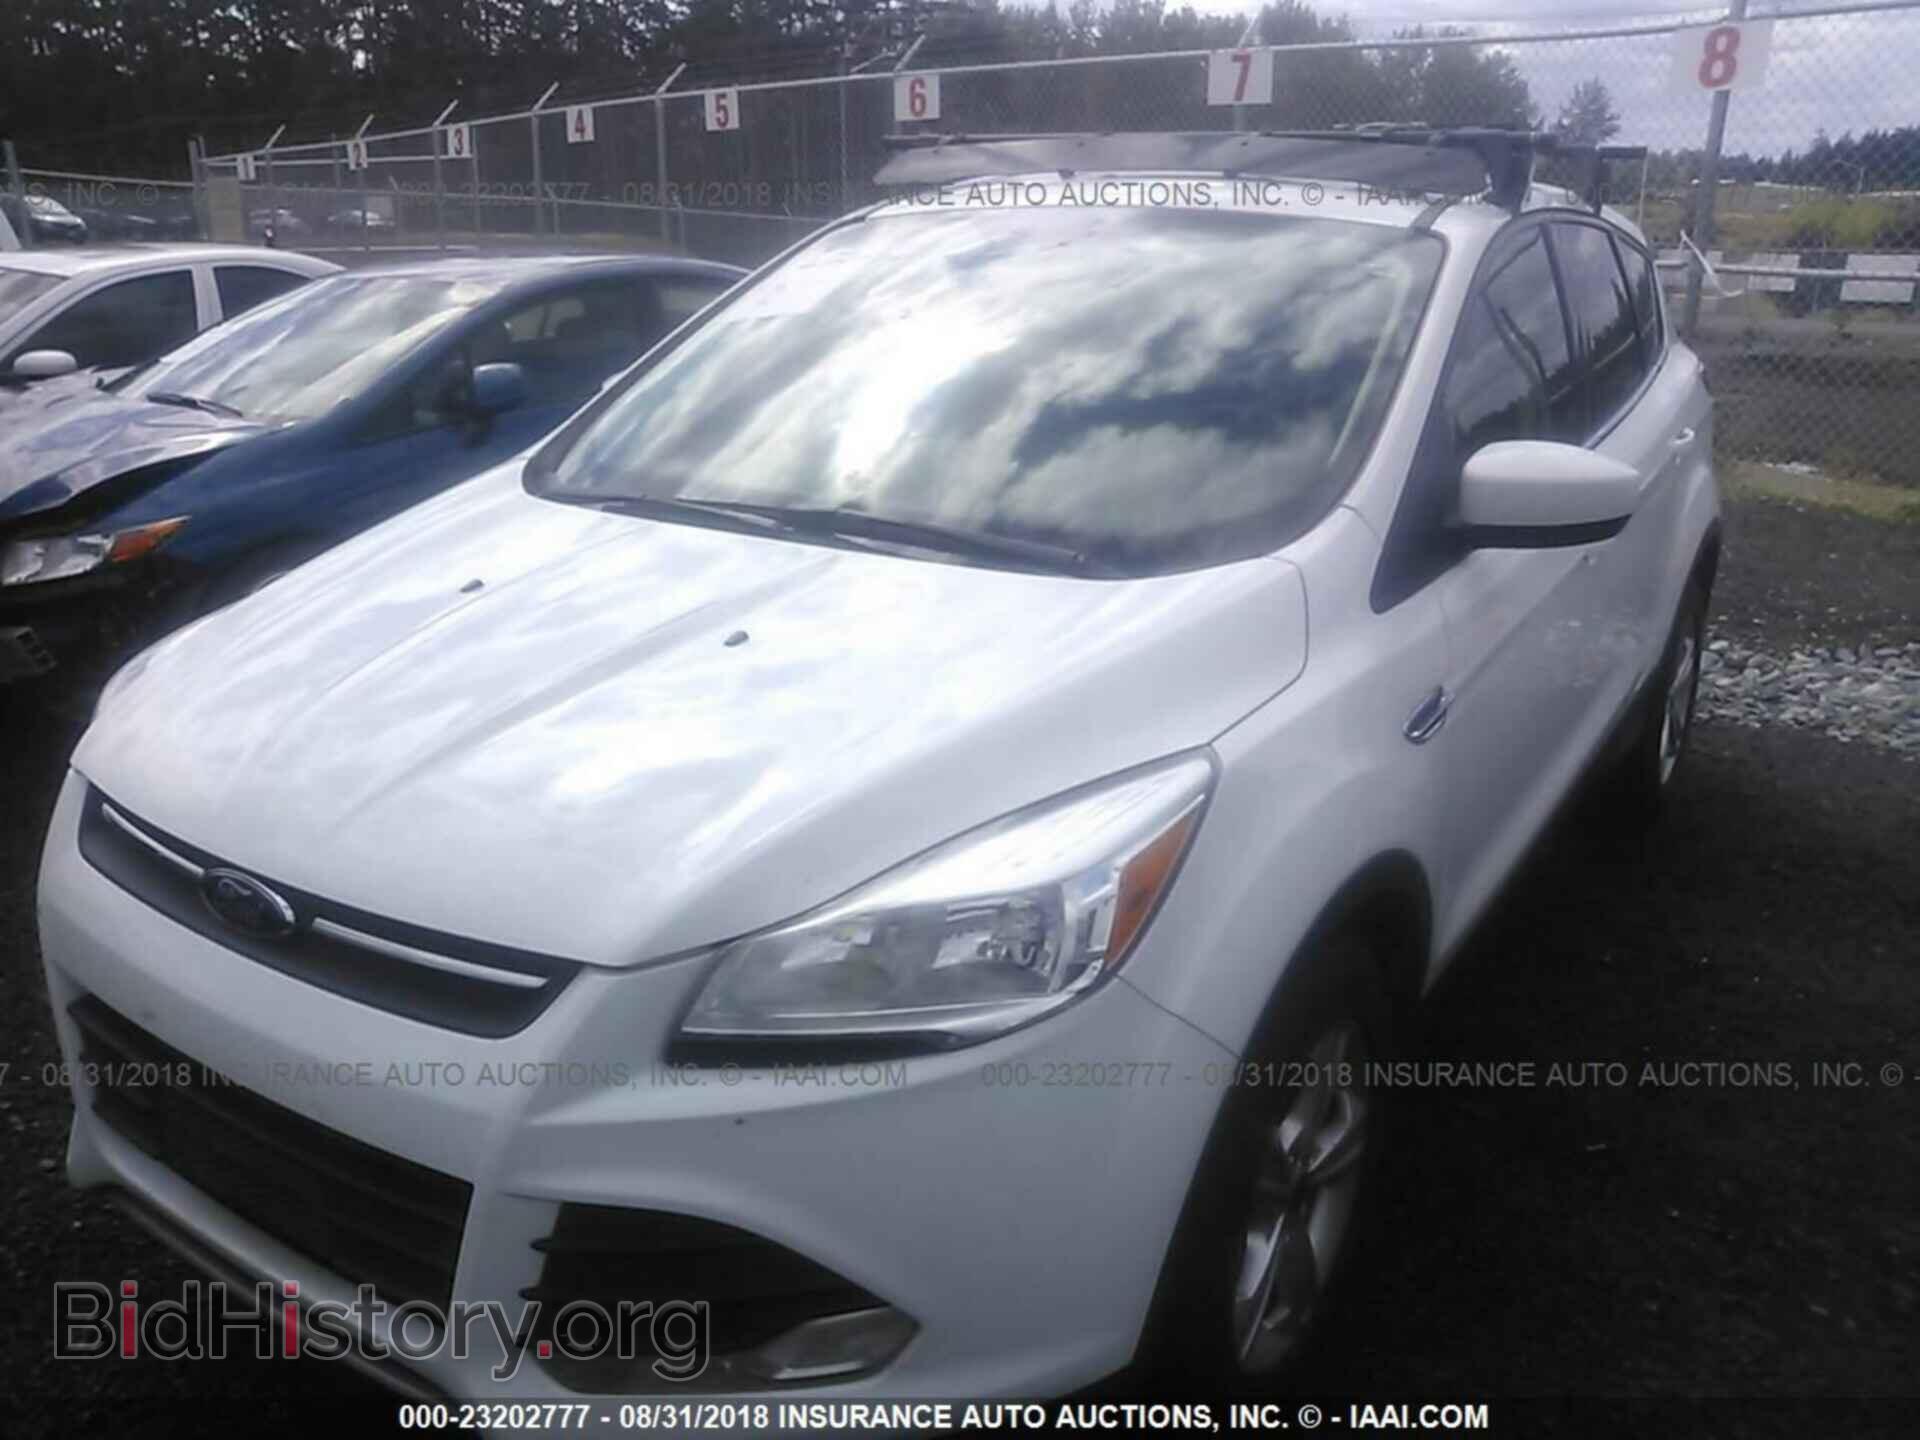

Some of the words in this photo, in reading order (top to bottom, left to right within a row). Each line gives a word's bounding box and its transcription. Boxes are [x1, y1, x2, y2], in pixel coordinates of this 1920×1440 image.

[1698, 26, 1741, 88] 8
[1231, 54, 1251, 101] 7
[715, 94, 730, 128] 5
[909, 77, 928, 117] 6
[454, 127, 464, 155] 3
[574, 109, 586, 139] 4
